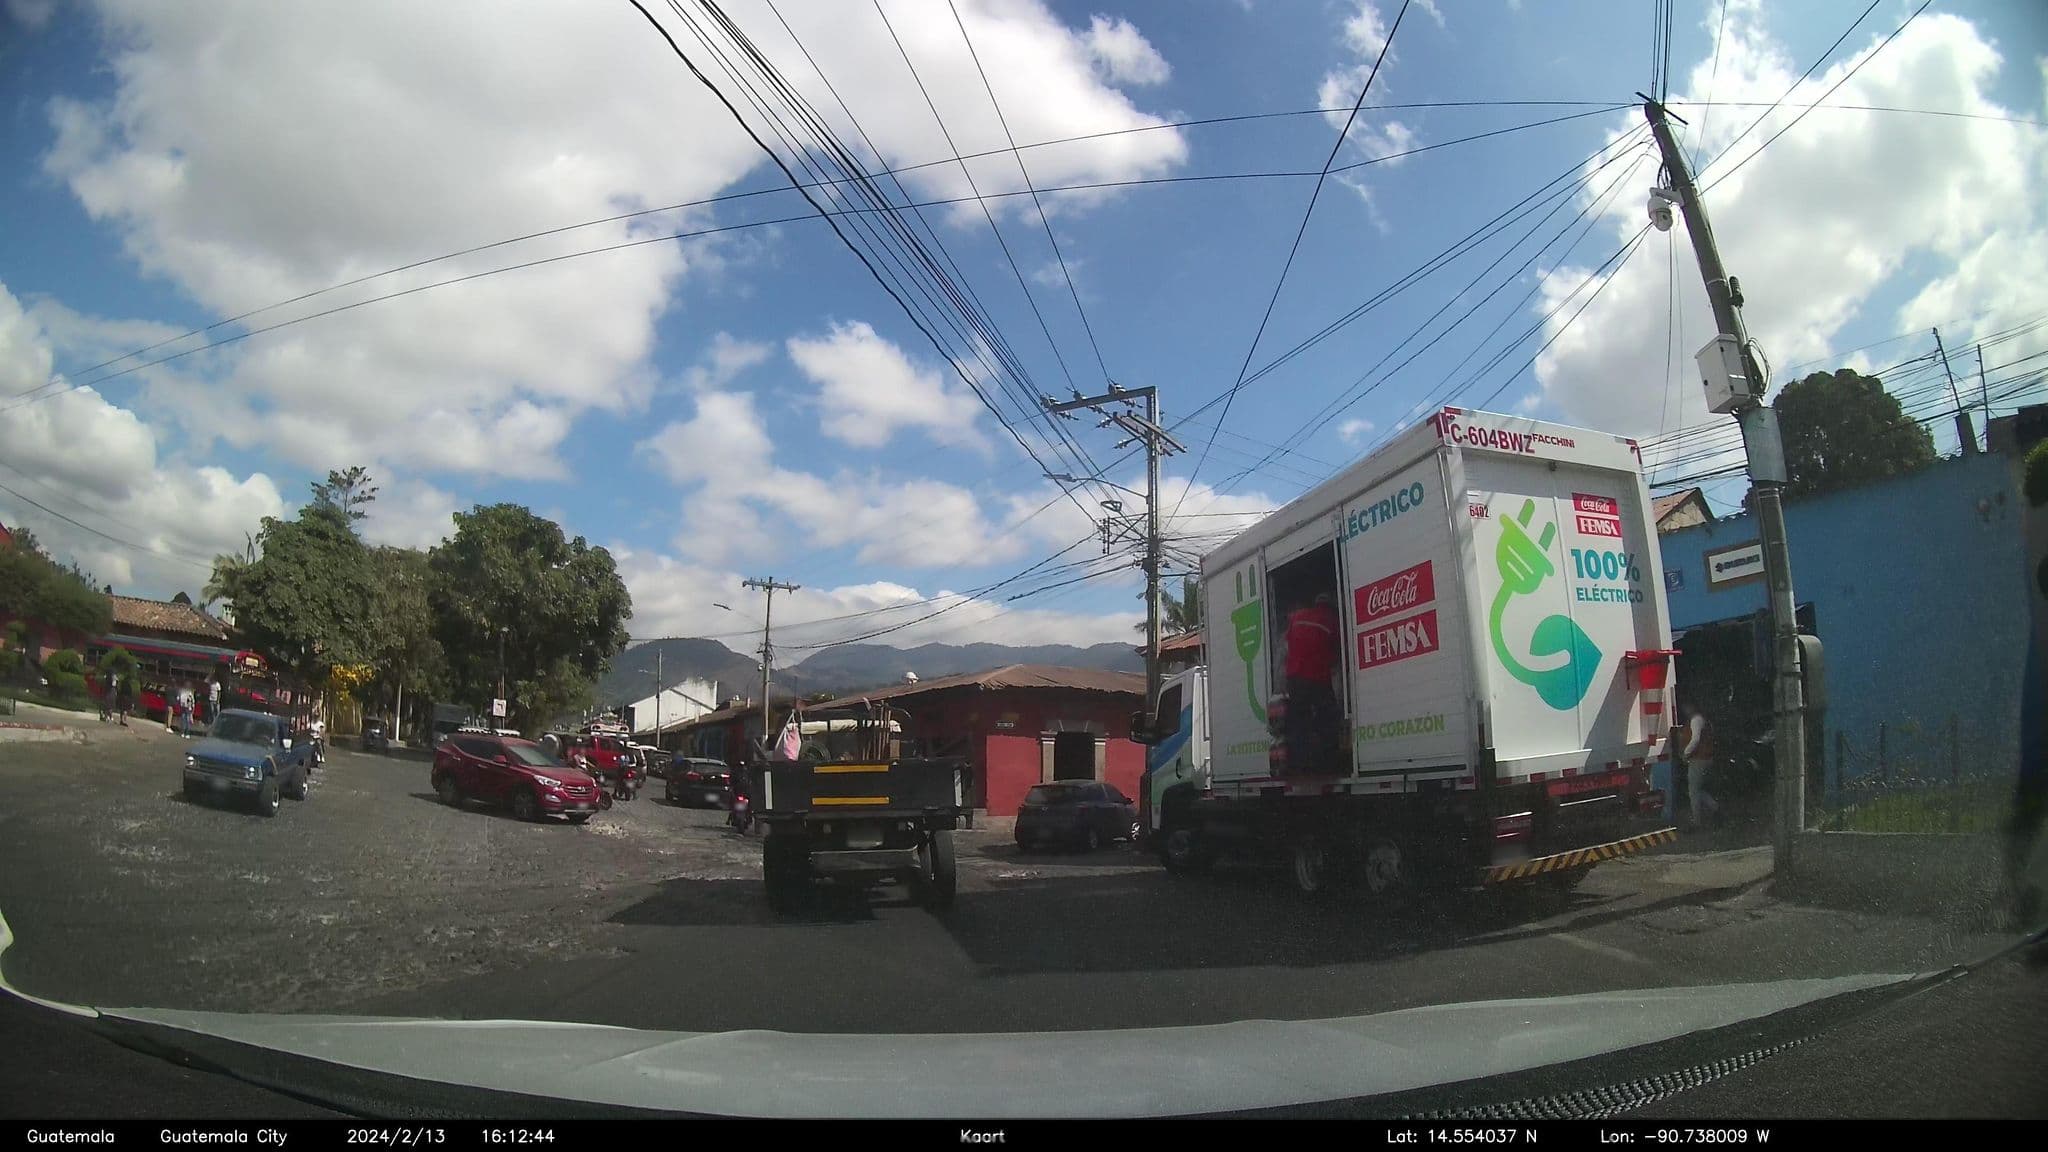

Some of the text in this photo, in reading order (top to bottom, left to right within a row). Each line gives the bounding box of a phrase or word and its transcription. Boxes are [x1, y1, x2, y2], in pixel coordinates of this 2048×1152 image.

[1451, 423, 1536, 454] C-604BWZ
[1532, 432, 1576, 449] FACCHINI
[1580, 518, 1619, 536] FEMSA
[1570, 548, 1641, 582] 100%
[1575, 583, 1644, 603] ELÉCTRICO
[1362, 619, 1432, 664] FEMSA
[1358, 712, 1445, 741] RO CORAZÓN
